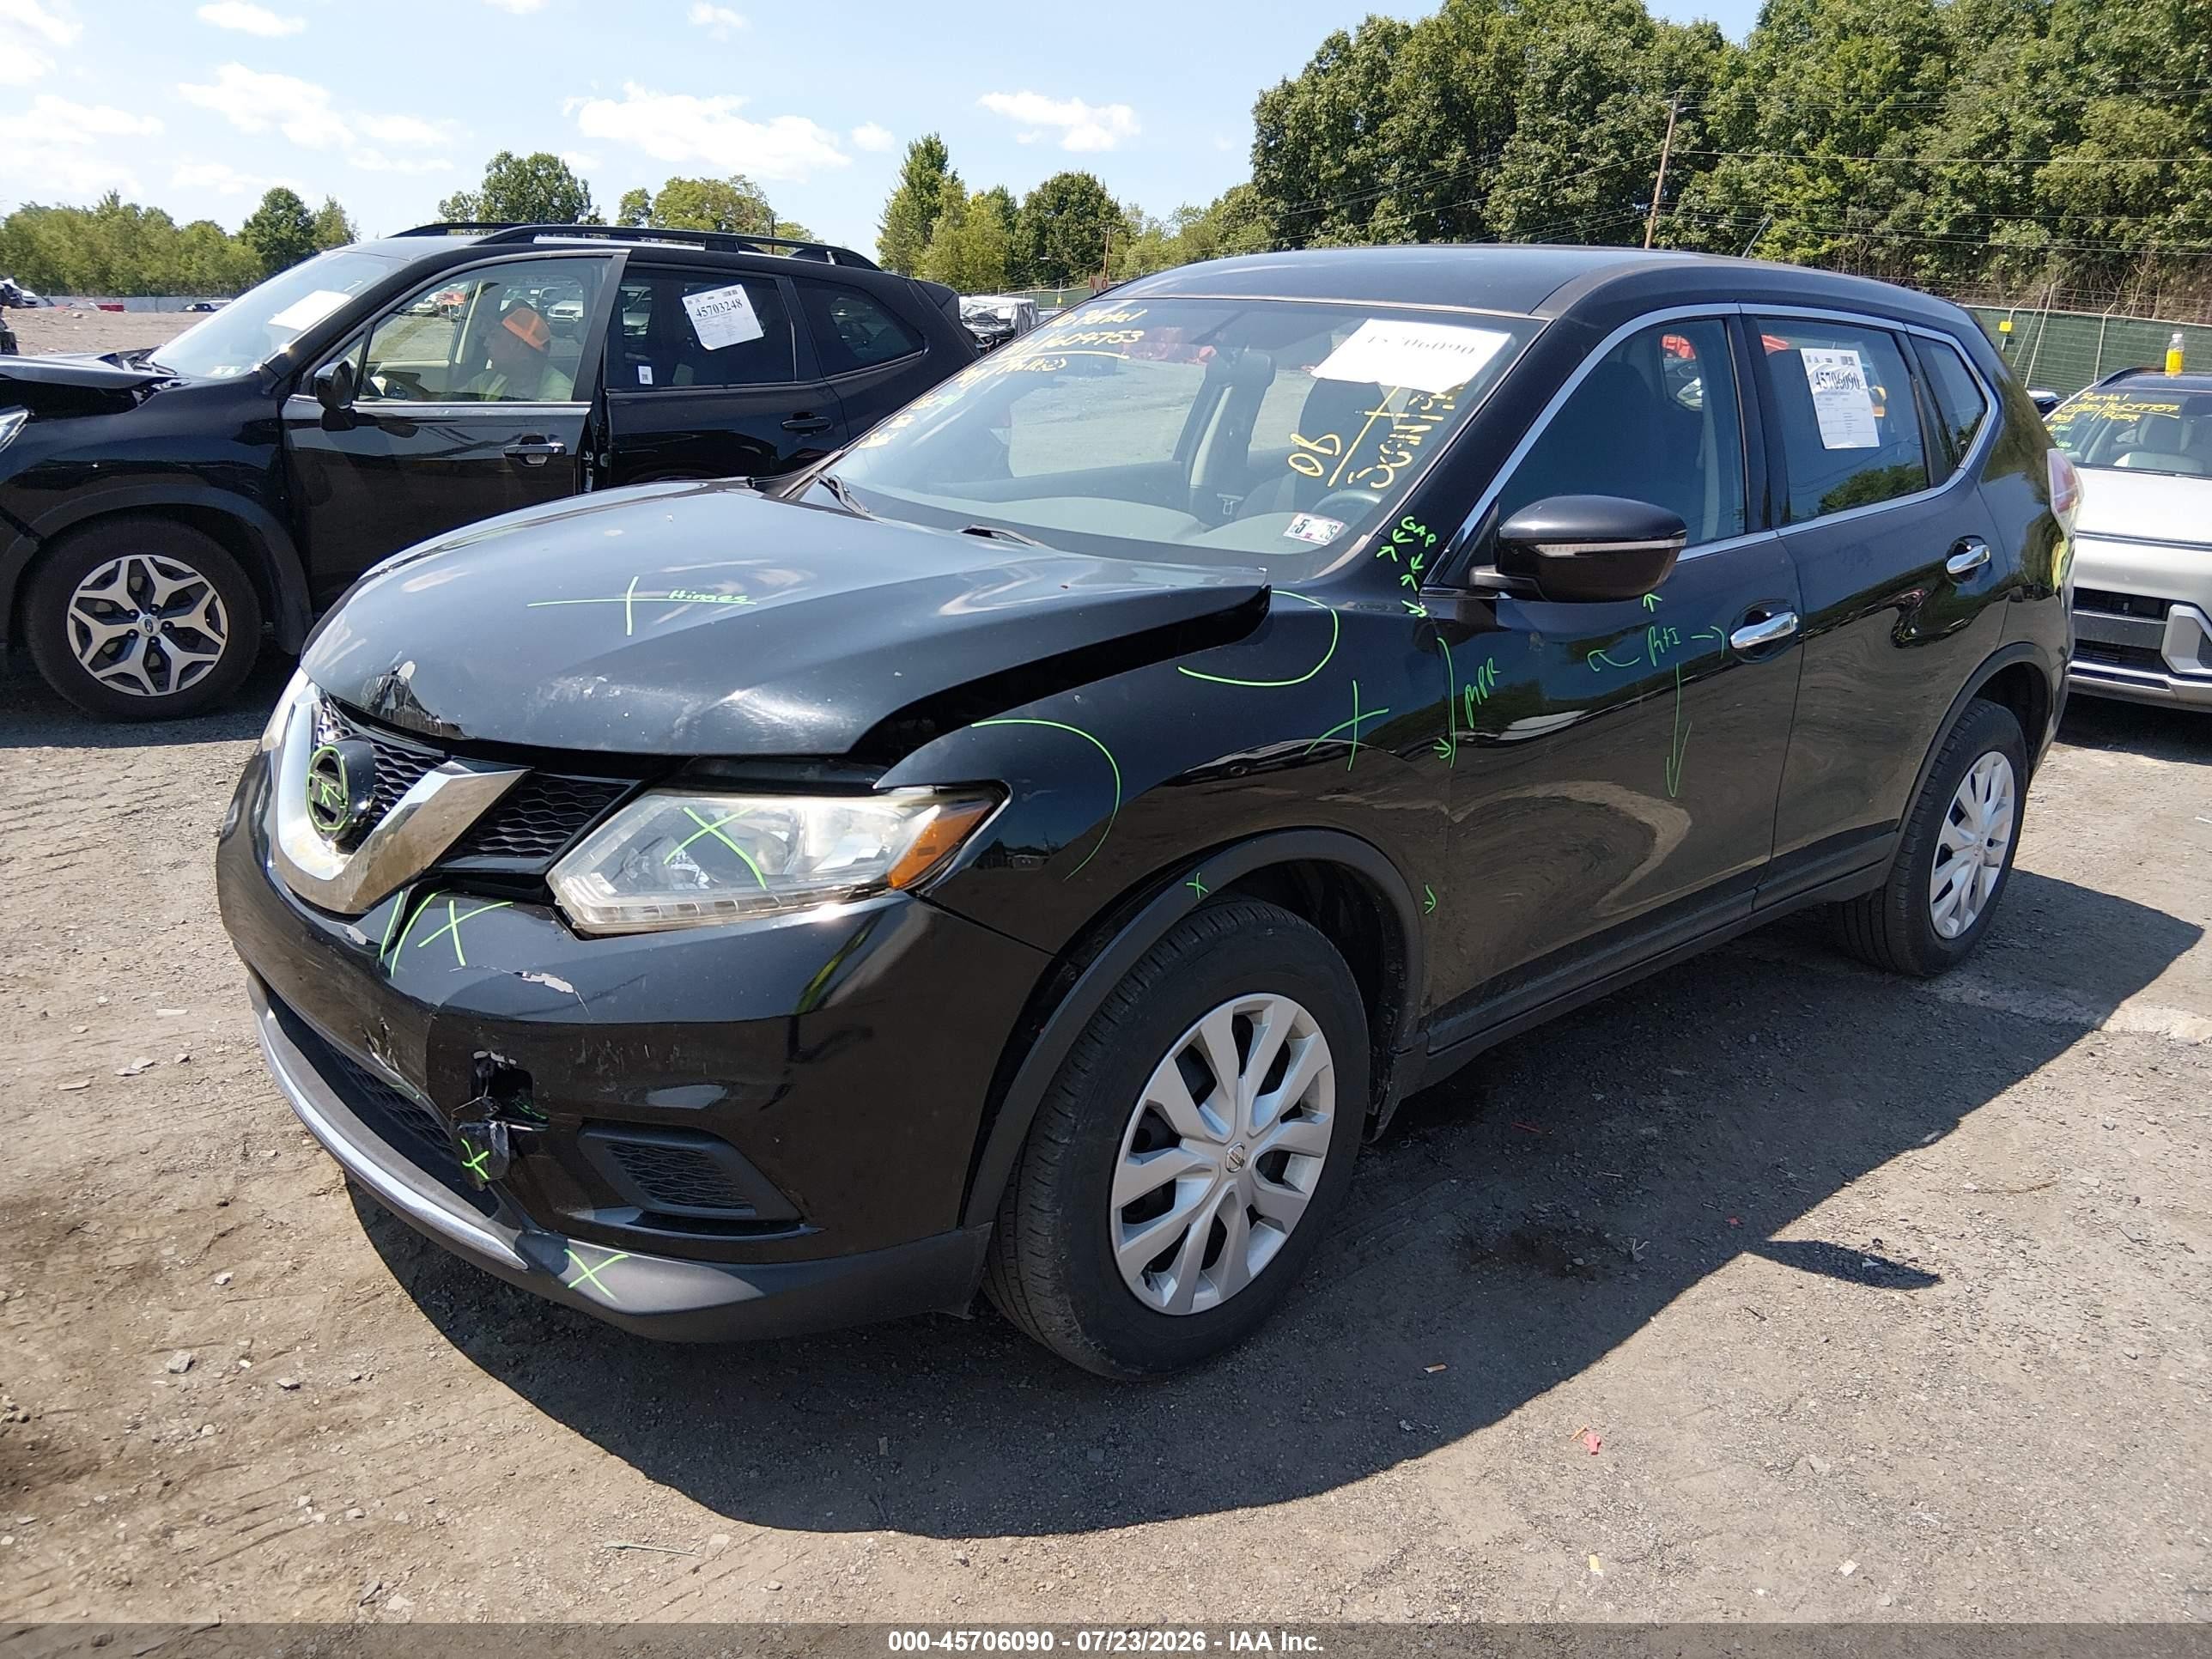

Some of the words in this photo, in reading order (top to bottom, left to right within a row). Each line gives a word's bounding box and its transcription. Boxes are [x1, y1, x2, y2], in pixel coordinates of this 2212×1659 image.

[696, 298, 743, 318] 45703248
[1814, 370, 1861, 391] 45706090
[1400, 515, 1437, 548] GAP
[668, 589, 749, 603] Hinges
